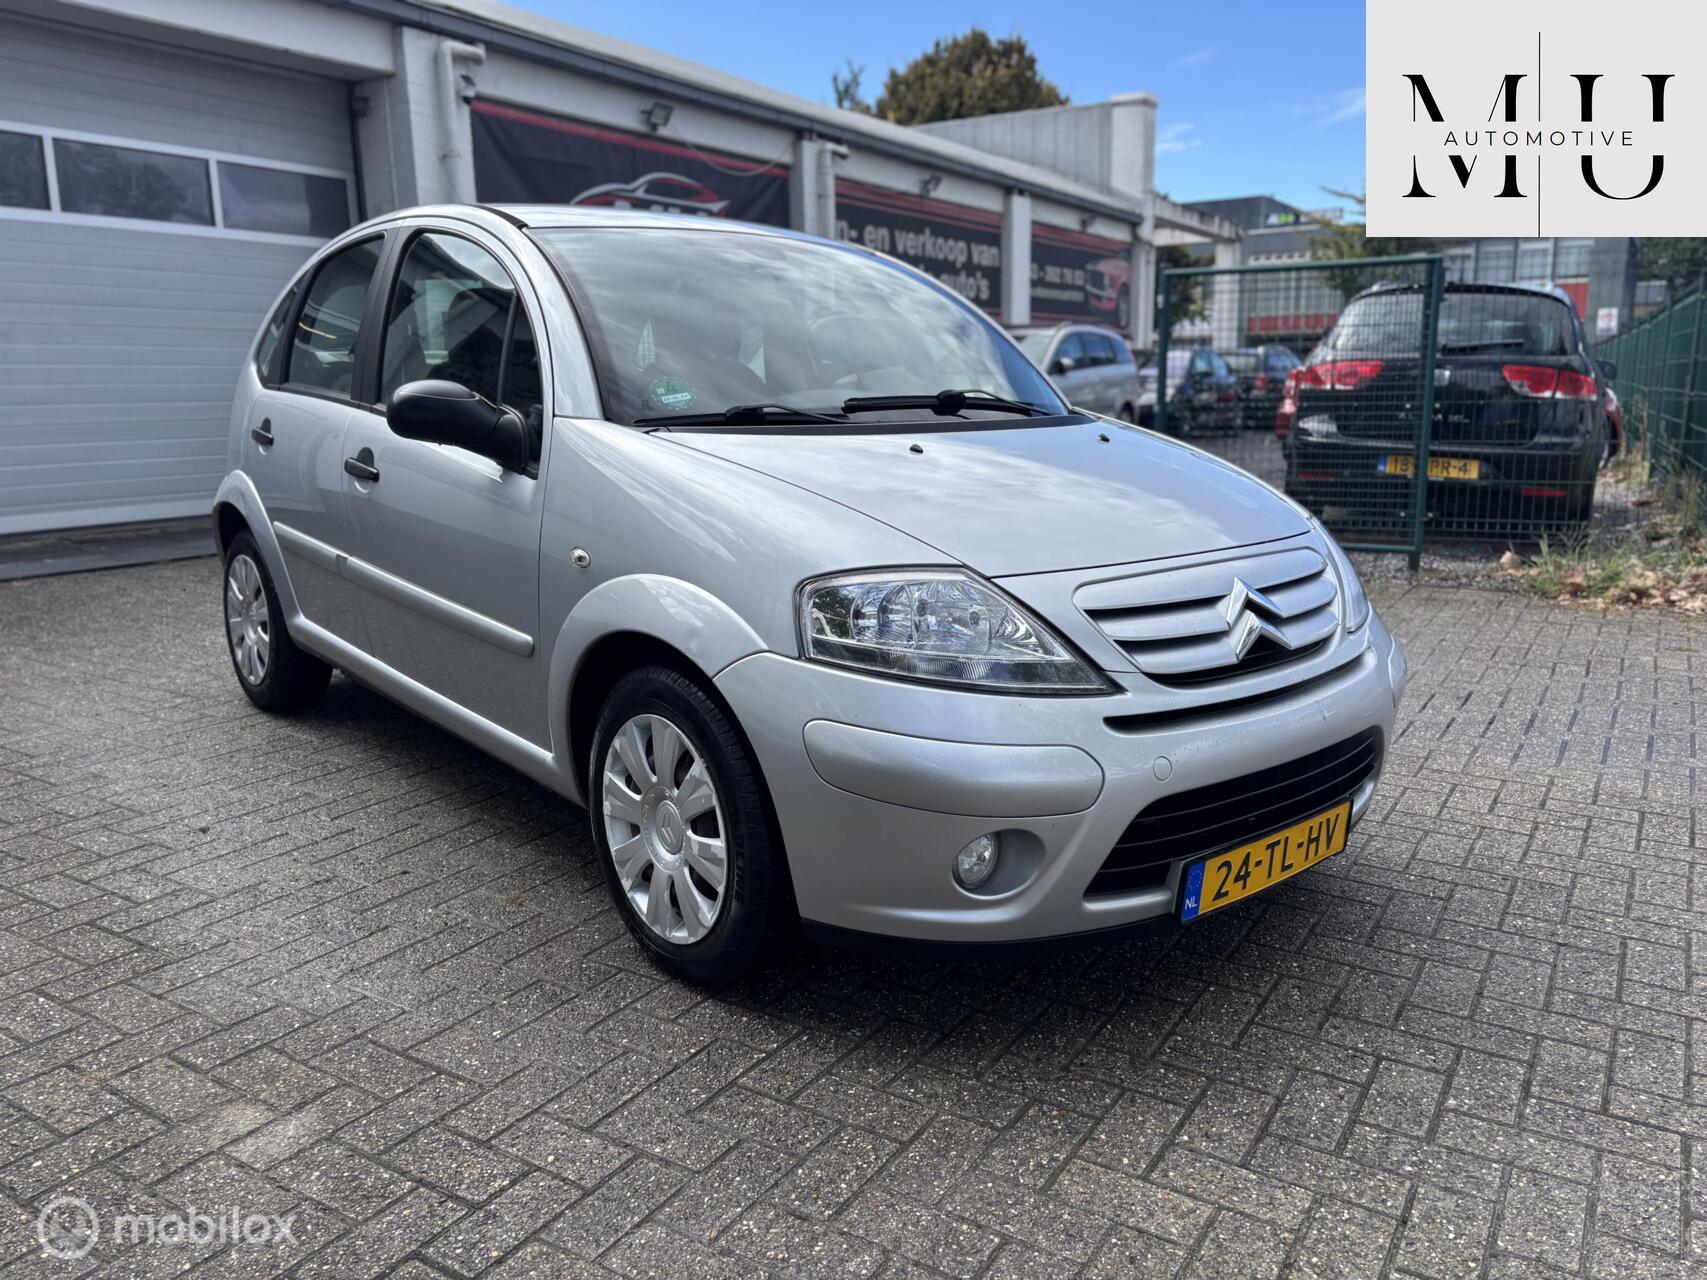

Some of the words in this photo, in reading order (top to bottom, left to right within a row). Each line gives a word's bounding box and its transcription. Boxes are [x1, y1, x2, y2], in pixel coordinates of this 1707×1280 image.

[863, 224, 891, 252] en
[894, 227, 968, 268] verkoop
[970, 242, 1000, 268] van
[1213, 813, 1340, 902] 24-TL-HV
[1184, 895, 1198, 911] NL
